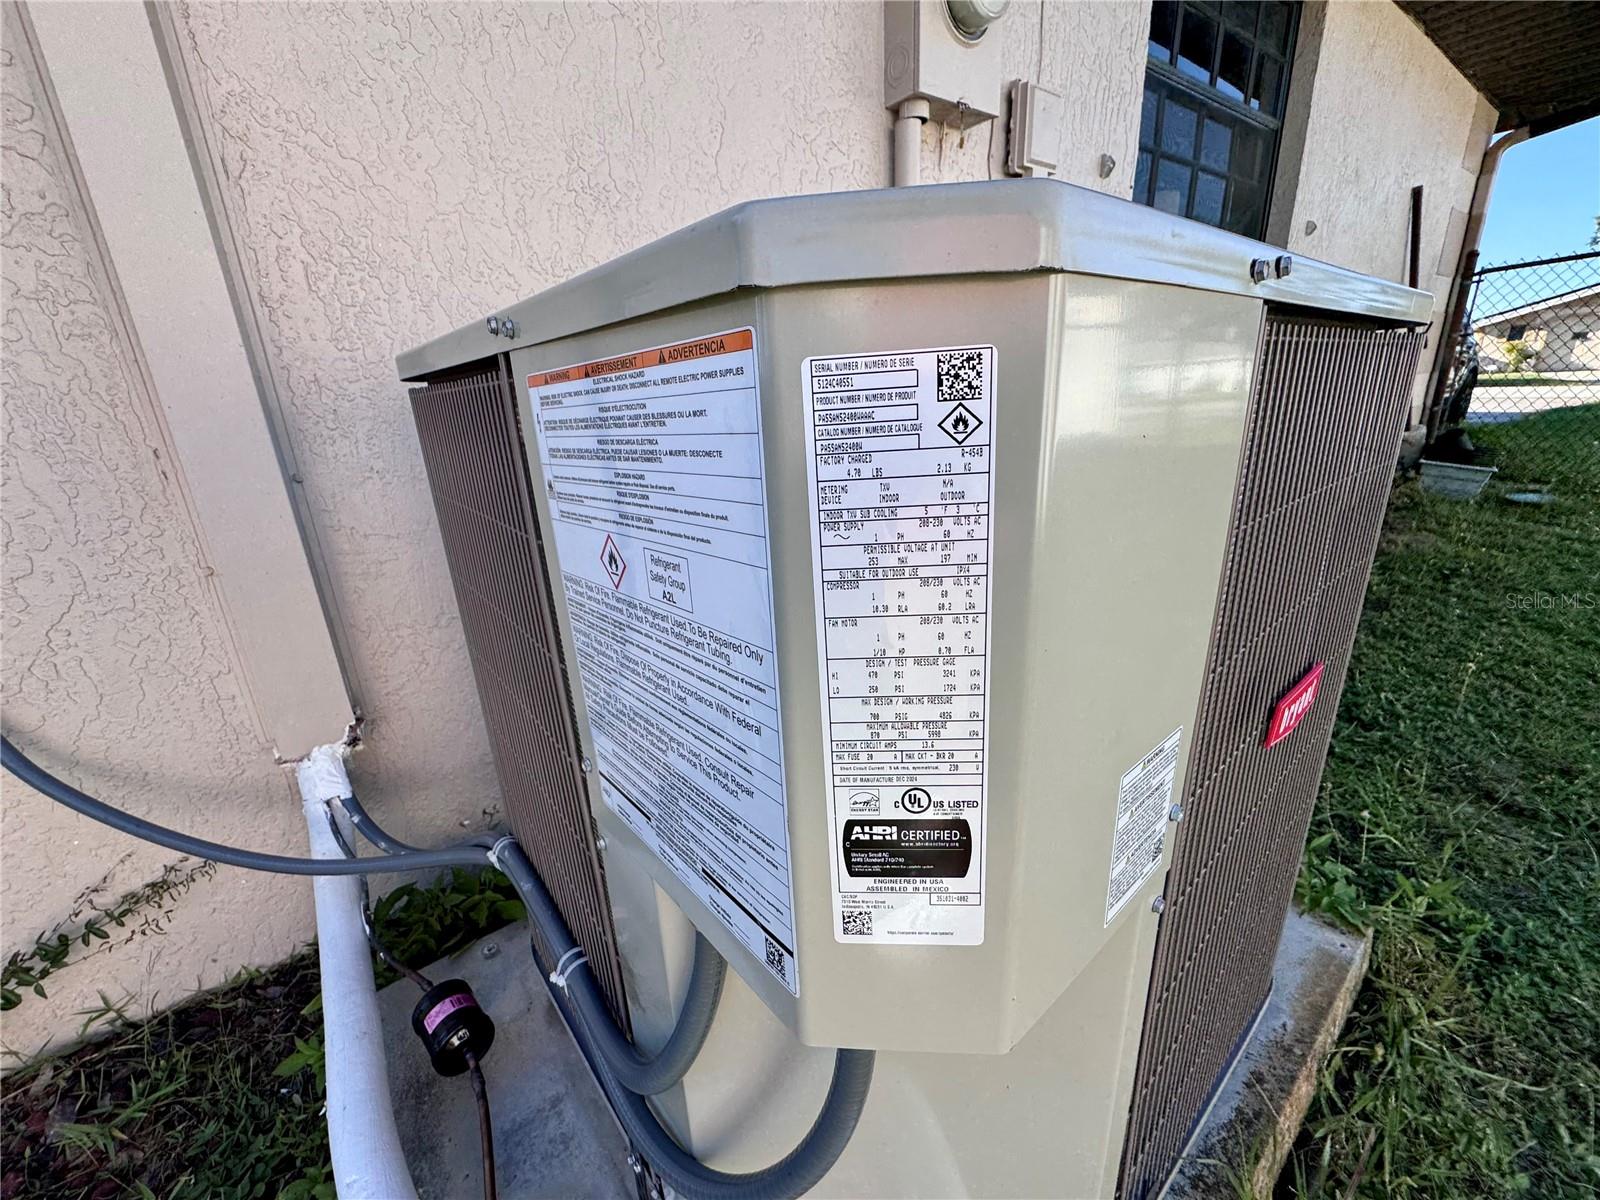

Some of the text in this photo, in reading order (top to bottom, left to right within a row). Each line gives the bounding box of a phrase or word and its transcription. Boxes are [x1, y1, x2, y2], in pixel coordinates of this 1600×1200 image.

[668, 340, 726, 360] ADVERTENCIA
[591, 357, 637, 375] AVERTISSEMENT
[815, 358, 914, 373] SERIAL NUMBER NUMERO DE SERIE
[549, 371, 570, 382] WARNING
[628, 371, 645, 380] HAZARD
[661, 376, 677, 385] REMOTE
[679, 373, 700, 383] ELECTRIC
[700, 370, 718, 380] POWER
[719, 366, 744, 377] SUPPLIES
[818, 377, 854, 389] 5124C40551
[816, 391, 916, 405] PRODUCT NUMBER NUMERO DE PRODUIT
[685, 410, 692, 418] LA
[692, 409, 708, 417] MORT.
[818, 423, 923, 437] CATALOG NUMBER NUMERO DE CATALOGUE
[689, 450, 723, 458] DESCONECTE
[961, 448, 983, 458] R-454B
[820, 454, 872, 466] FACTORY CHARGED
[872, 462, 971, 477] LBS 2.13 KG
[821, 479, 953, 495] METERING TXV N/A
[821, 490, 965, 505] DEVICE INDOOR OUTDOOR
[824, 508, 897, 520] INDOOR TXV SUB COOLING
[824, 517, 981, 532] POWER SUPPLY VOLTS AC
[875, 529, 974, 542] 1 PH HZ
[864, 542, 955, 554] PERMISSIBLE VOLTAGE AT UNIT
[650, 554, 681, 573] Refrigerant
[868, 553, 977, 566] 253 MAX 197 MIN
[839, 566, 970, 579] SUITABLE FOR OUTDOOR USE IPX4
[650, 570, 686, 591] Safety Group
[826, 577, 980, 590] COMPRESSOR VOLTS AC
[662, 590, 676, 604] A2L
[872, 589, 972, 600] 1 PH HZ
[898, 602, 975, 613] RLA LRA
[841, 619, 857, 627] MOTOR
[952, 616, 969, 624] VOLTS
[611, 592, 638, 610] Flammable
[639, 602, 670, 625] Refrigerant
[688, 622, 697, 635] To
[698, 626, 707, 640] Be
[709, 631, 742, 654] Repaired
[745, 645, 763, 666] Only
[625, 609, 632, 619] Do
[634, 613, 644, 624] Not
[645, 617, 669, 636] Puncture
[671, 628, 705, 652] Refrigerant
[706, 642, 733, 666] Tubing.
[877, 634, 880, 642] 1
[964, 646, 974, 654] FLA
[866, 658, 939, 668] DESIGN TEST PRESSURE
[894, 669, 980, 679] PSI 3241 KPA
[642, 672, 672, 696] Refrigerant
[895, 683, 980, 693] PSI 1724 KPA
[640, 660, 762, 736] Of Properly Accordance With Federal
[874, 696, 952, 706] DESIGN WORKING PRESSURE
[895, 711, 979, 720] PSIG KPA
[891, 722, 919, 730] ALLOWABLE
[922, 721, 947, 730] PRESSURE
[677, 747, 741, 801] Service This Product.
[705, 757, 755, 799] Consult Repair
[909, 794, 924, 808] UL
[851, 826, 960, 840] AHRI CERTIFIED
